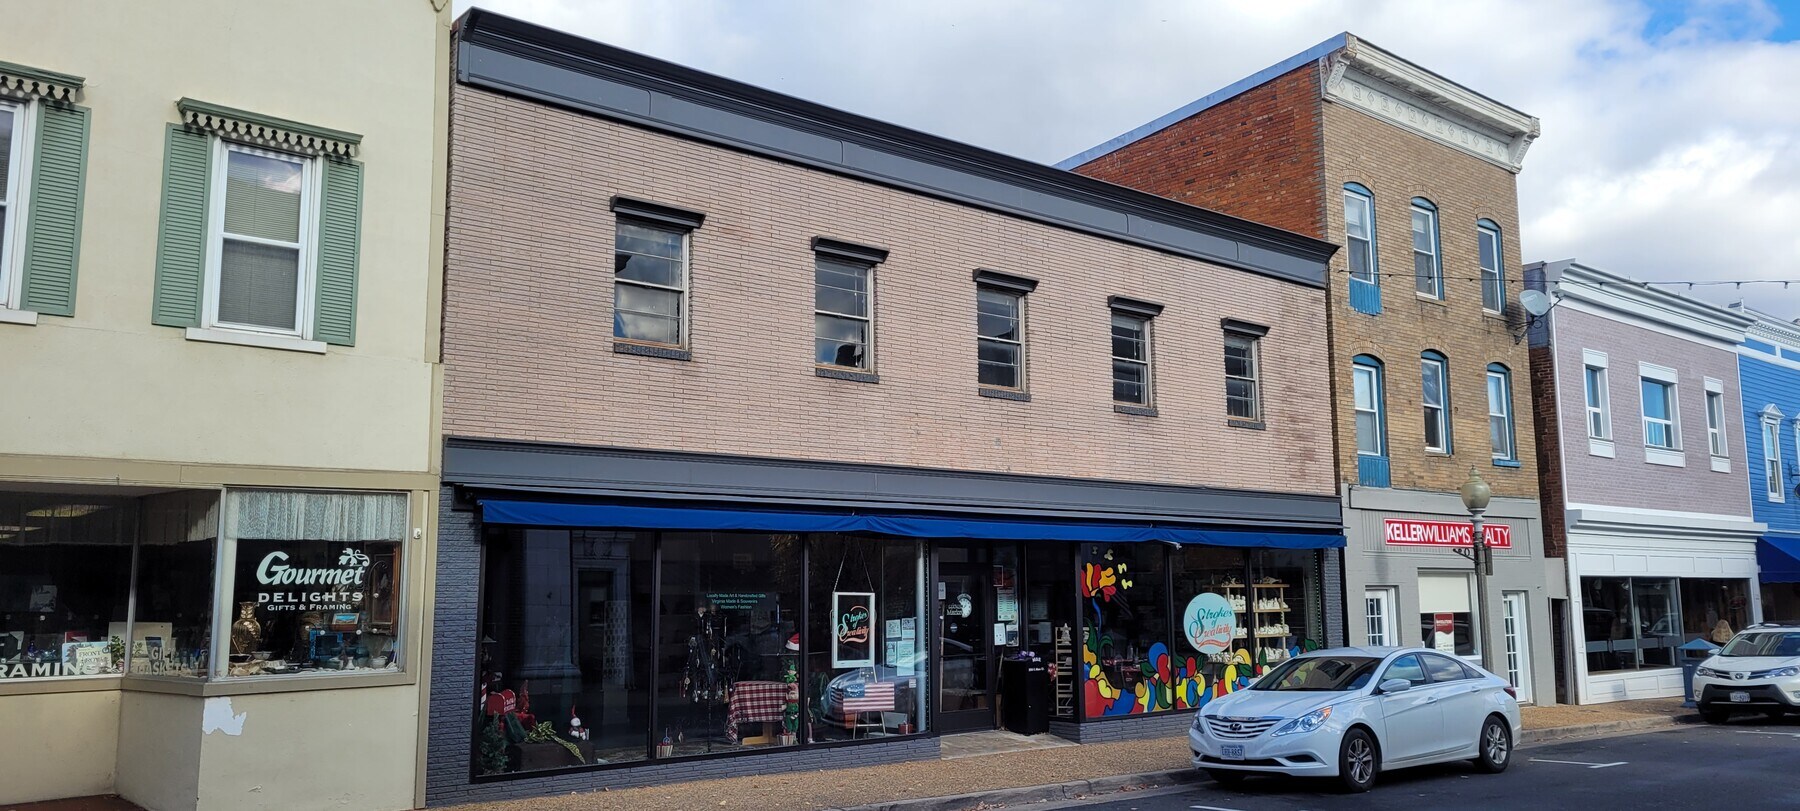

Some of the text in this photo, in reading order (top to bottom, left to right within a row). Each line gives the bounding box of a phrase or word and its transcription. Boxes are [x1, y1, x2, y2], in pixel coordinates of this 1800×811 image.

[1474, 527, 1509, 545] ALTY
[256, 550, 365, 586] Gourmet
[258, 591, 363, 603] DELIGHTS
[1189, 607, 1233, 639] Strokes
